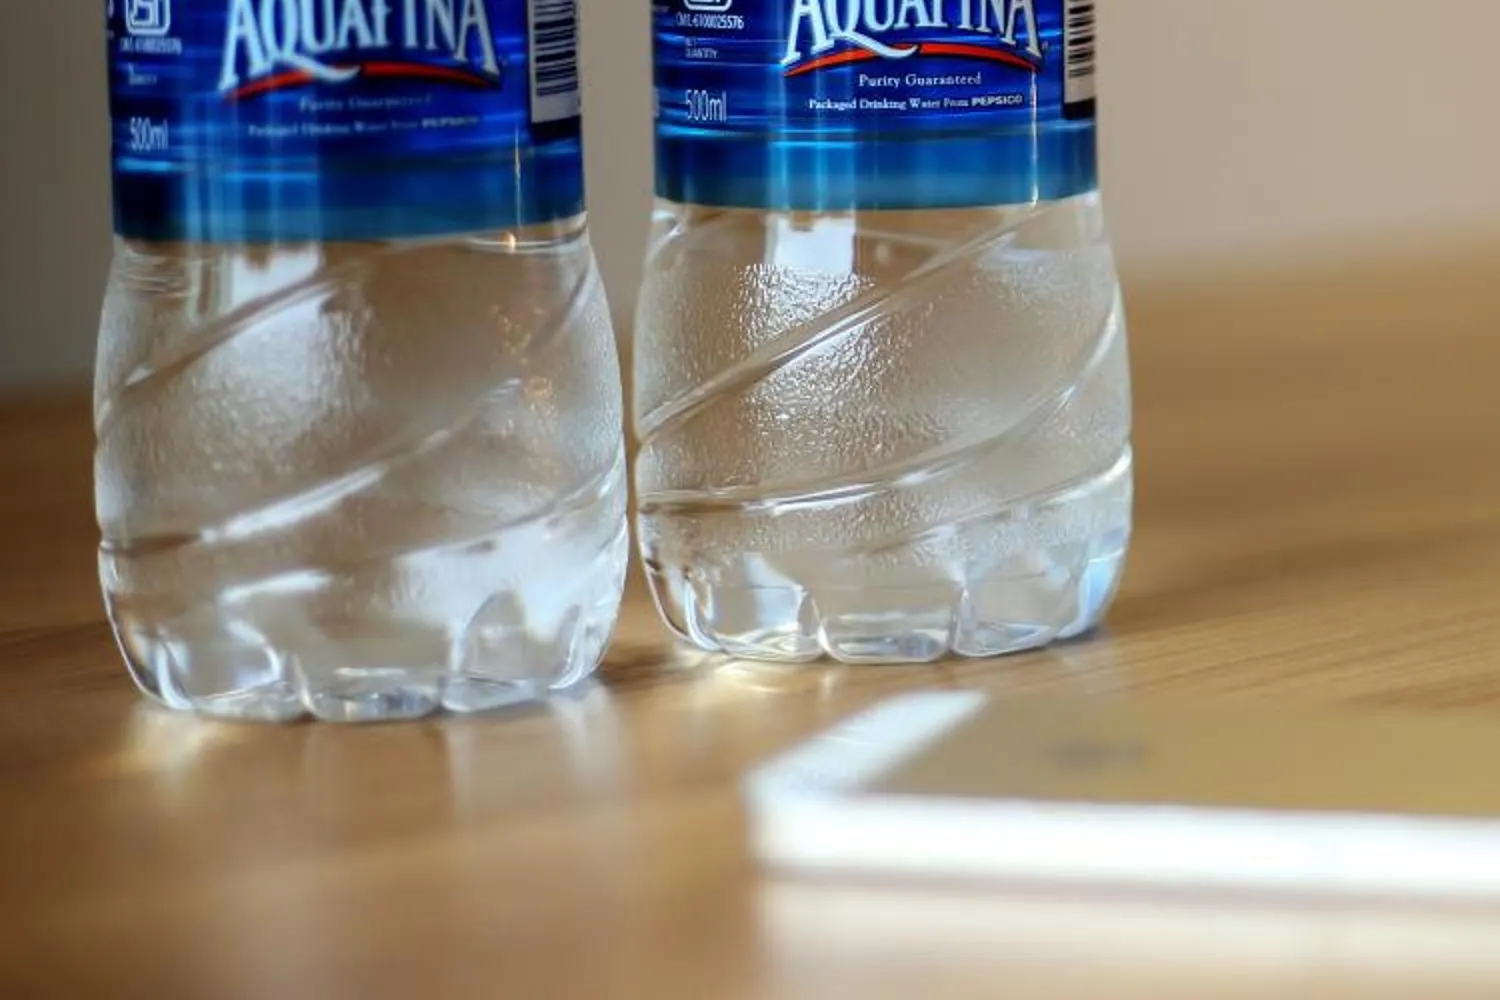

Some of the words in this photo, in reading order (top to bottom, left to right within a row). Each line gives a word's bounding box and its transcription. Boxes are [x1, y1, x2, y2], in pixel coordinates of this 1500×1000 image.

[859, 74, 900, 88] Purity
[905, 71, 982, 87] Guaranteed
[685, 89, 727, 123] 500ml
[809, 97, 857, 111] Packaged
[859, 97, 907, 110] Drinking
[971, 94, 1023, 107] PEPSICO
[130, 115, 168, 151] 500ml
